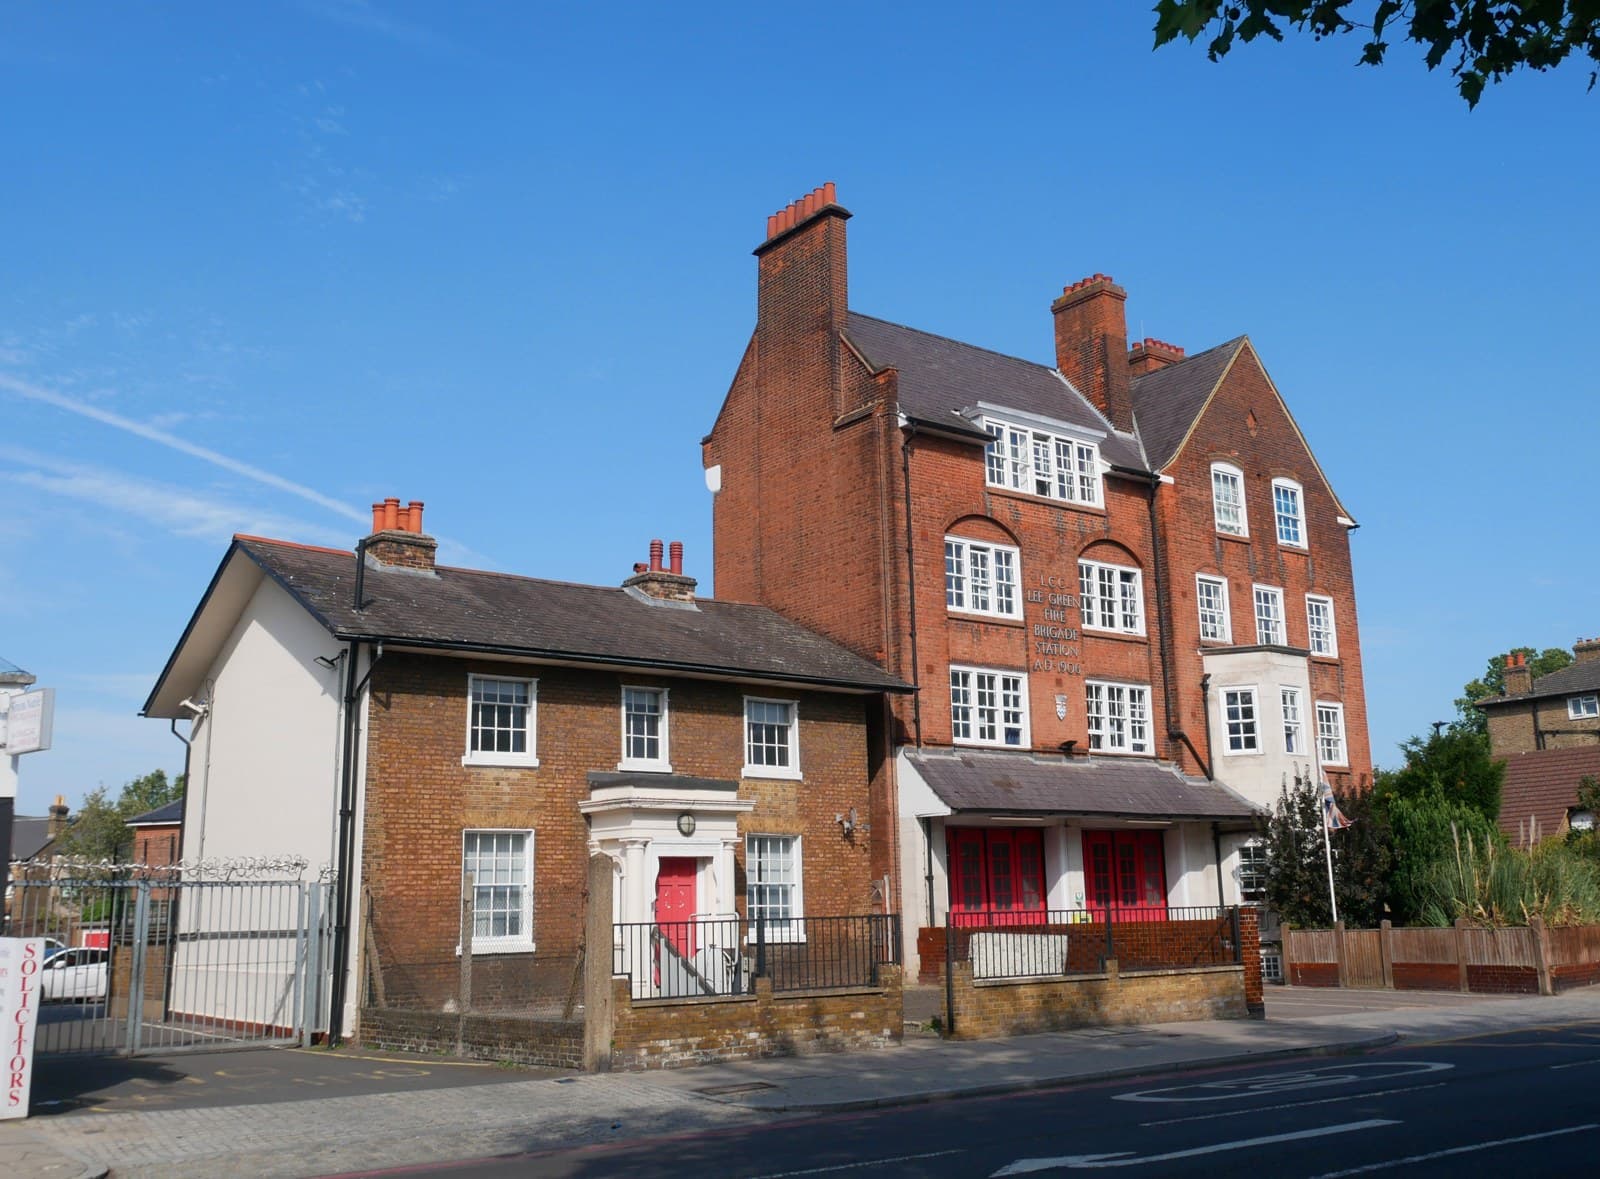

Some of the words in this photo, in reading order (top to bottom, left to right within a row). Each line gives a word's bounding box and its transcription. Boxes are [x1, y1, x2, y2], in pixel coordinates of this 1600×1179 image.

[1027, 590, 1044, 603] LEE
[1048, 592, 1081, 608] GREEN
[1044, 608, 1066, 623] FIRE
[1034, 624, 1078, 641] BRIGADE
[1035, 641, 1079, 657] STATION
[8, 943, 37, 1107] SOLICITORS
